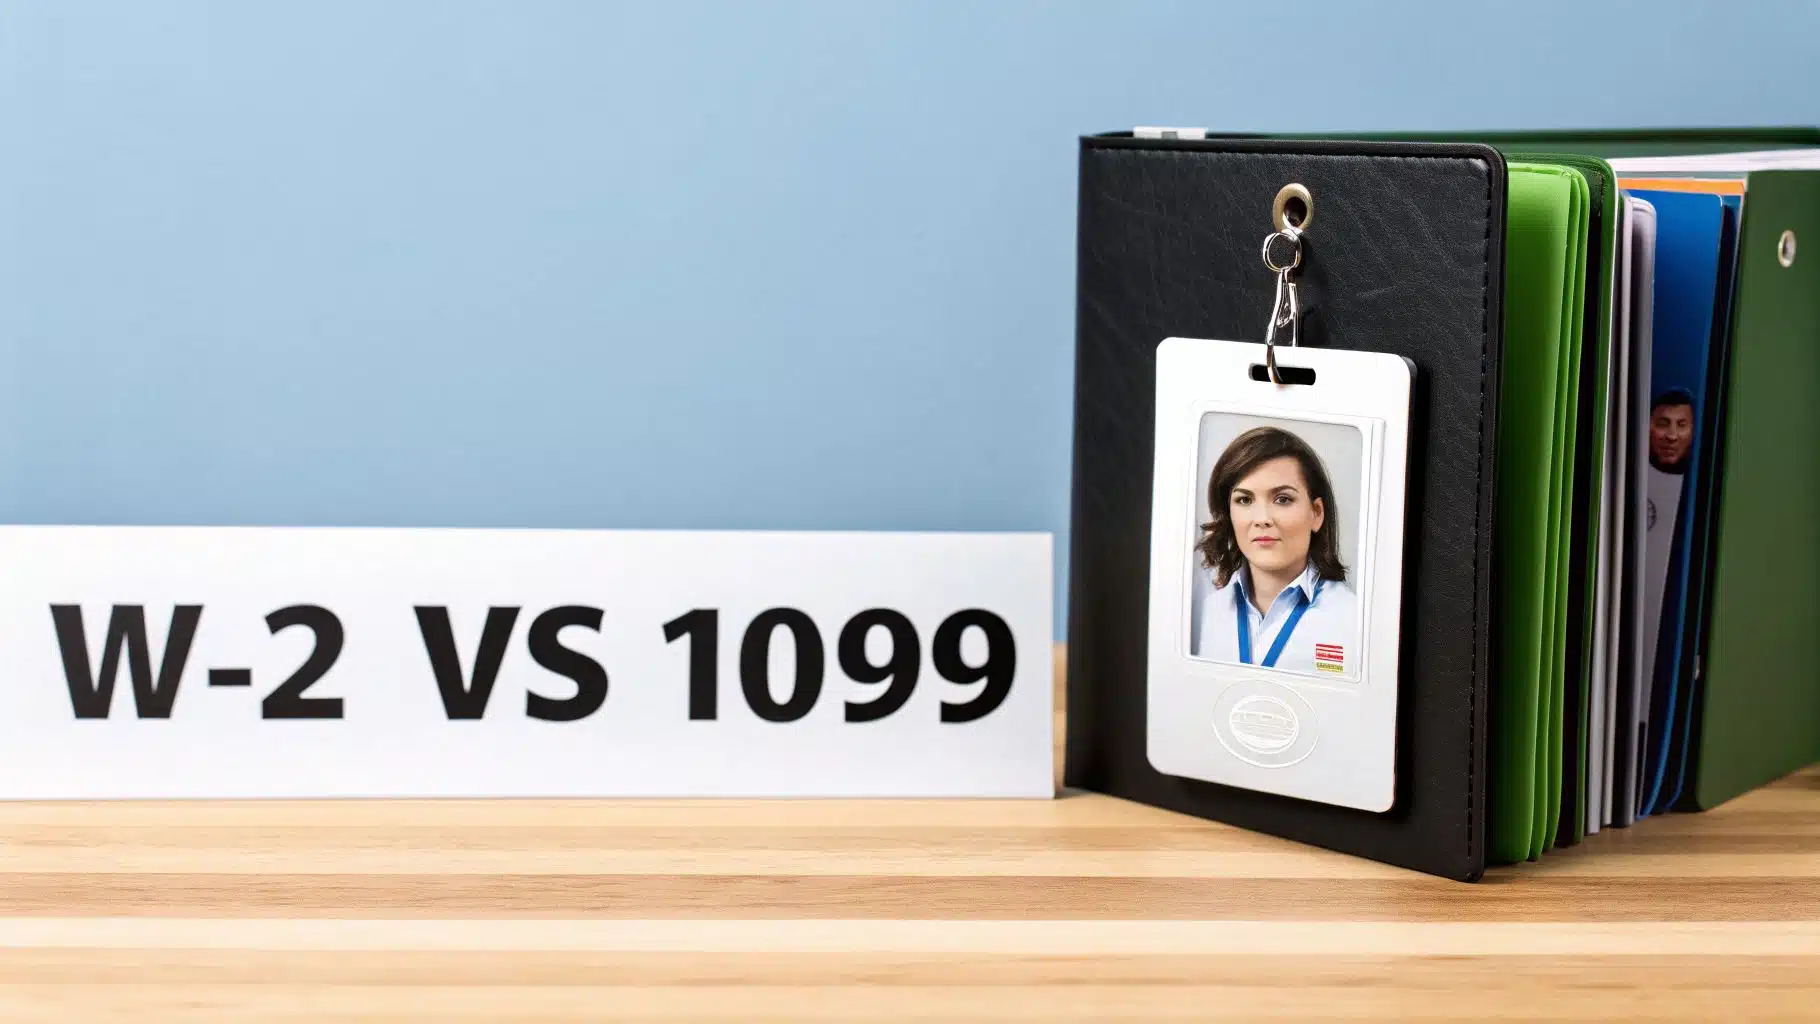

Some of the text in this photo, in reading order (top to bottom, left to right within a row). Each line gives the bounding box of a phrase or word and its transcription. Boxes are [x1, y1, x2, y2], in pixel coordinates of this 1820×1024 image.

[50, 603, 1018, 724] W-2 VS 1099
